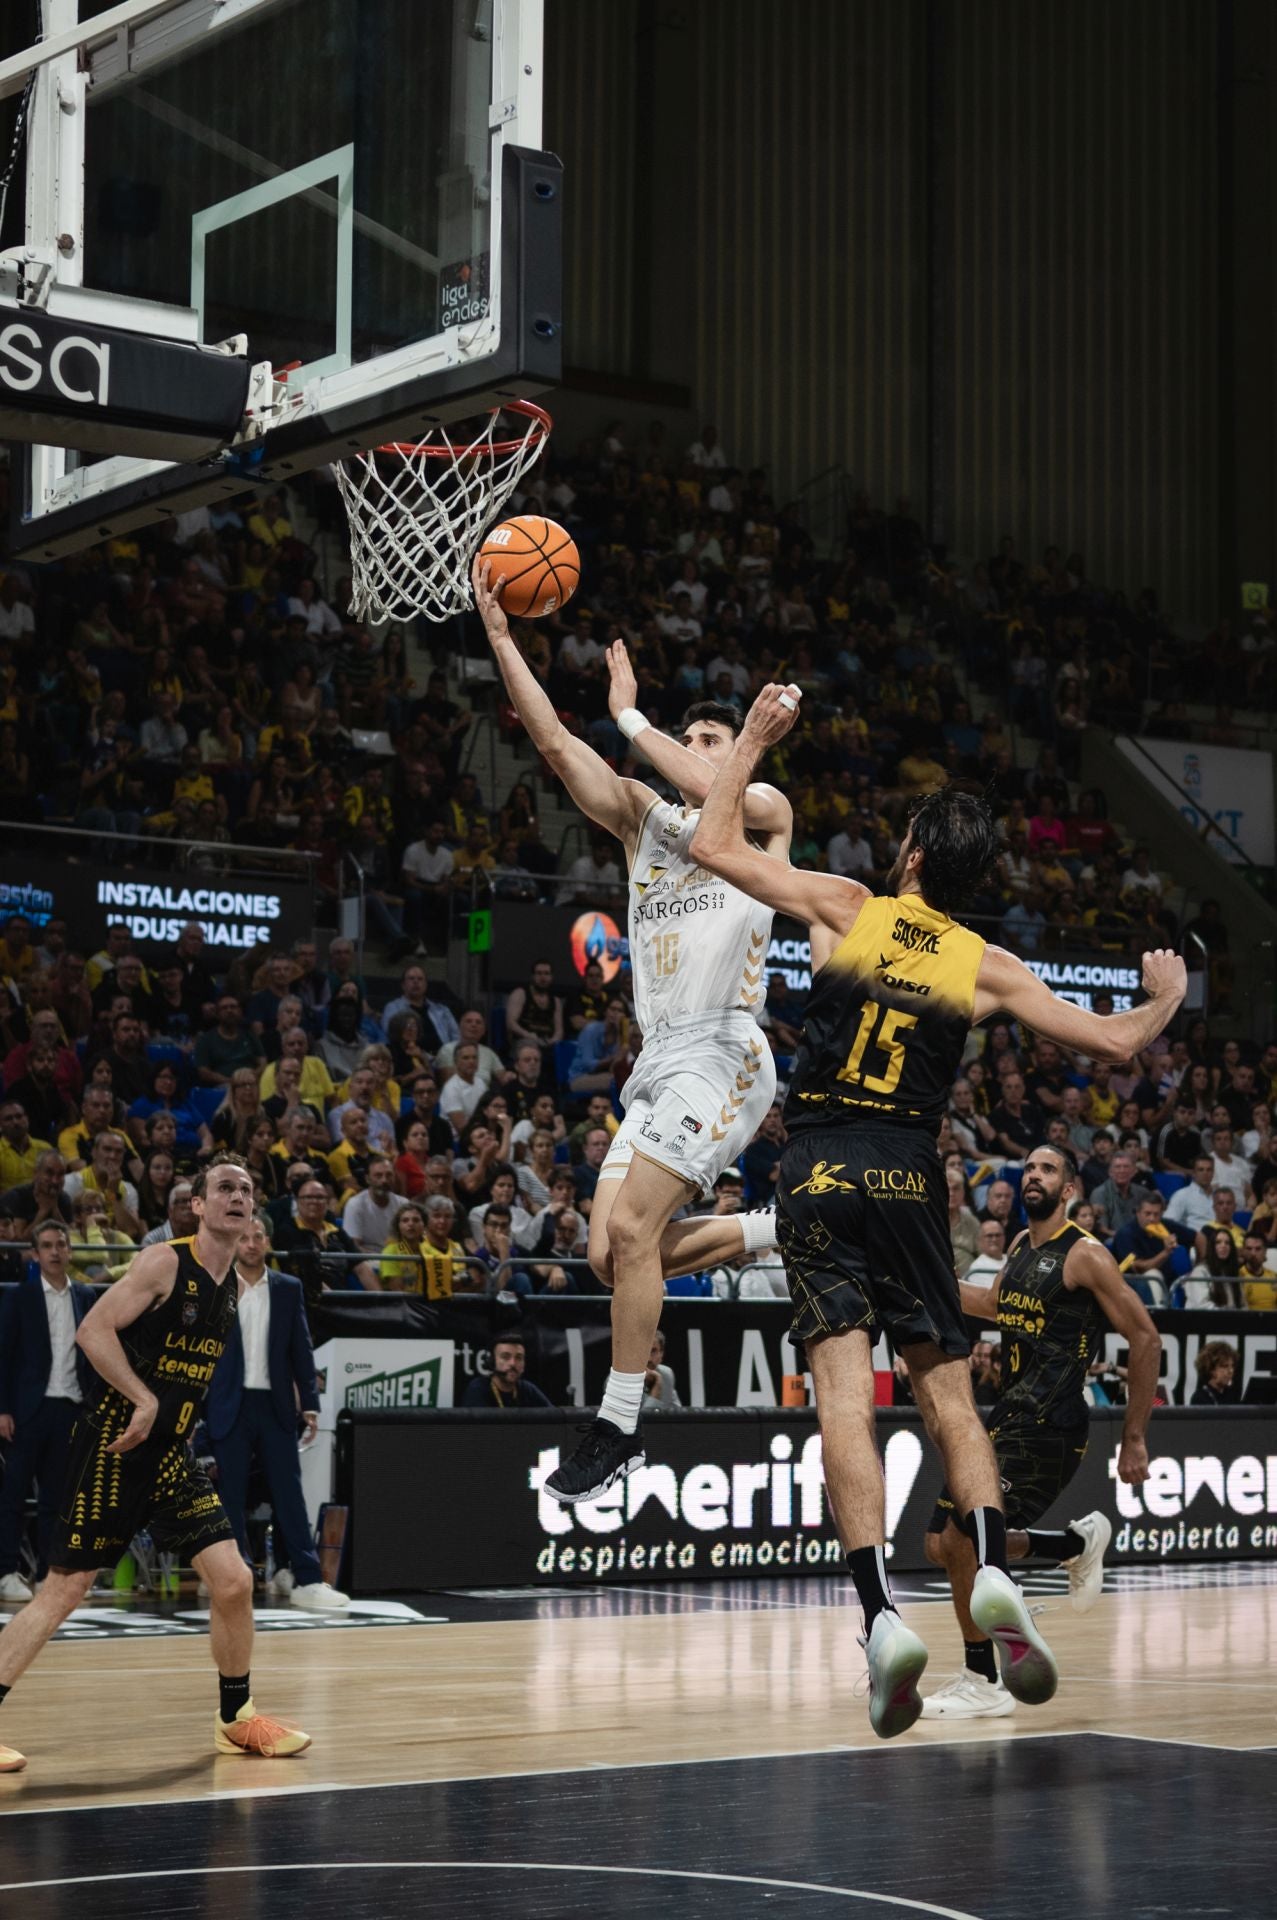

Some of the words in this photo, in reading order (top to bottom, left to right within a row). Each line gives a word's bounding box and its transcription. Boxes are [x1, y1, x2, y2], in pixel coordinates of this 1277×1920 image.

[441, 283, 468, 307] liga
[0, 323, 110, 407] sa
[97, 880, 281, 919] INSTALACIONES
[651, 932, 681, 977] 10
[835, 1000, 919, 1095] 15
[999, 1289, 1045, 1315] LAGUNA
[164, 1331, 187, 1351] LA
[347, 1370, 433, 1409] FINISHER
[175, 1401, 194, 1435] 9
[536, 1538, 696, 1577] despierta
[710, 1532, 847, 1567] emocion
[1115, 1520, 1239, 1556] despierta
